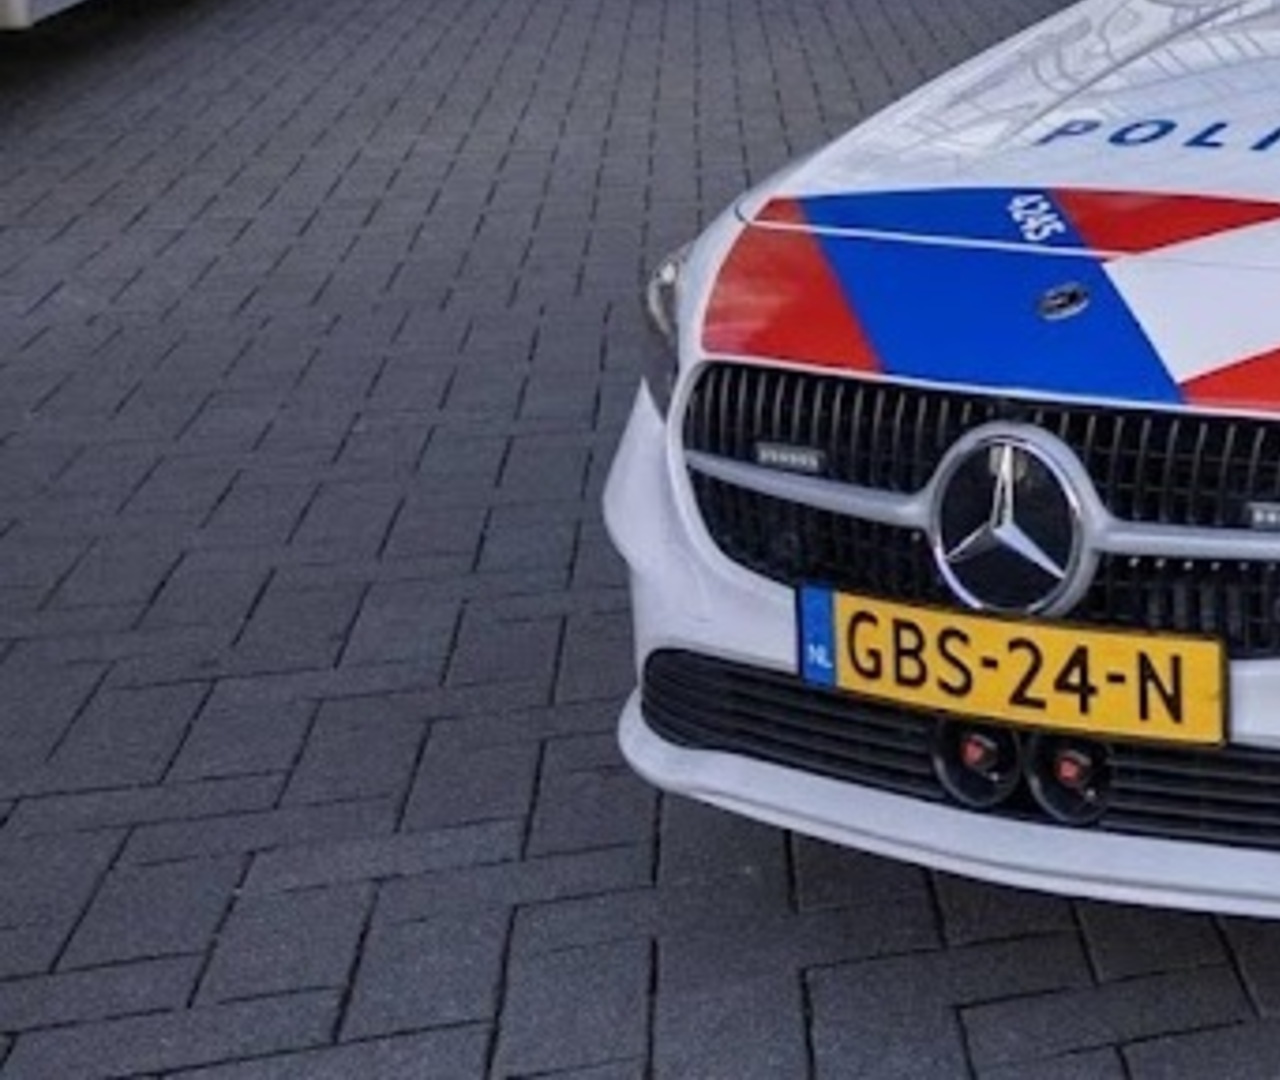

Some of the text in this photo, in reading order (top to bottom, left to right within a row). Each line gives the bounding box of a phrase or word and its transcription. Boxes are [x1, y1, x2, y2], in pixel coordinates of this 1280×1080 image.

[1007, 193, 1066, 242] 4245
[806, 643, 833, 669] NL
[846, 610, 1183, 724] GBS-24-N
